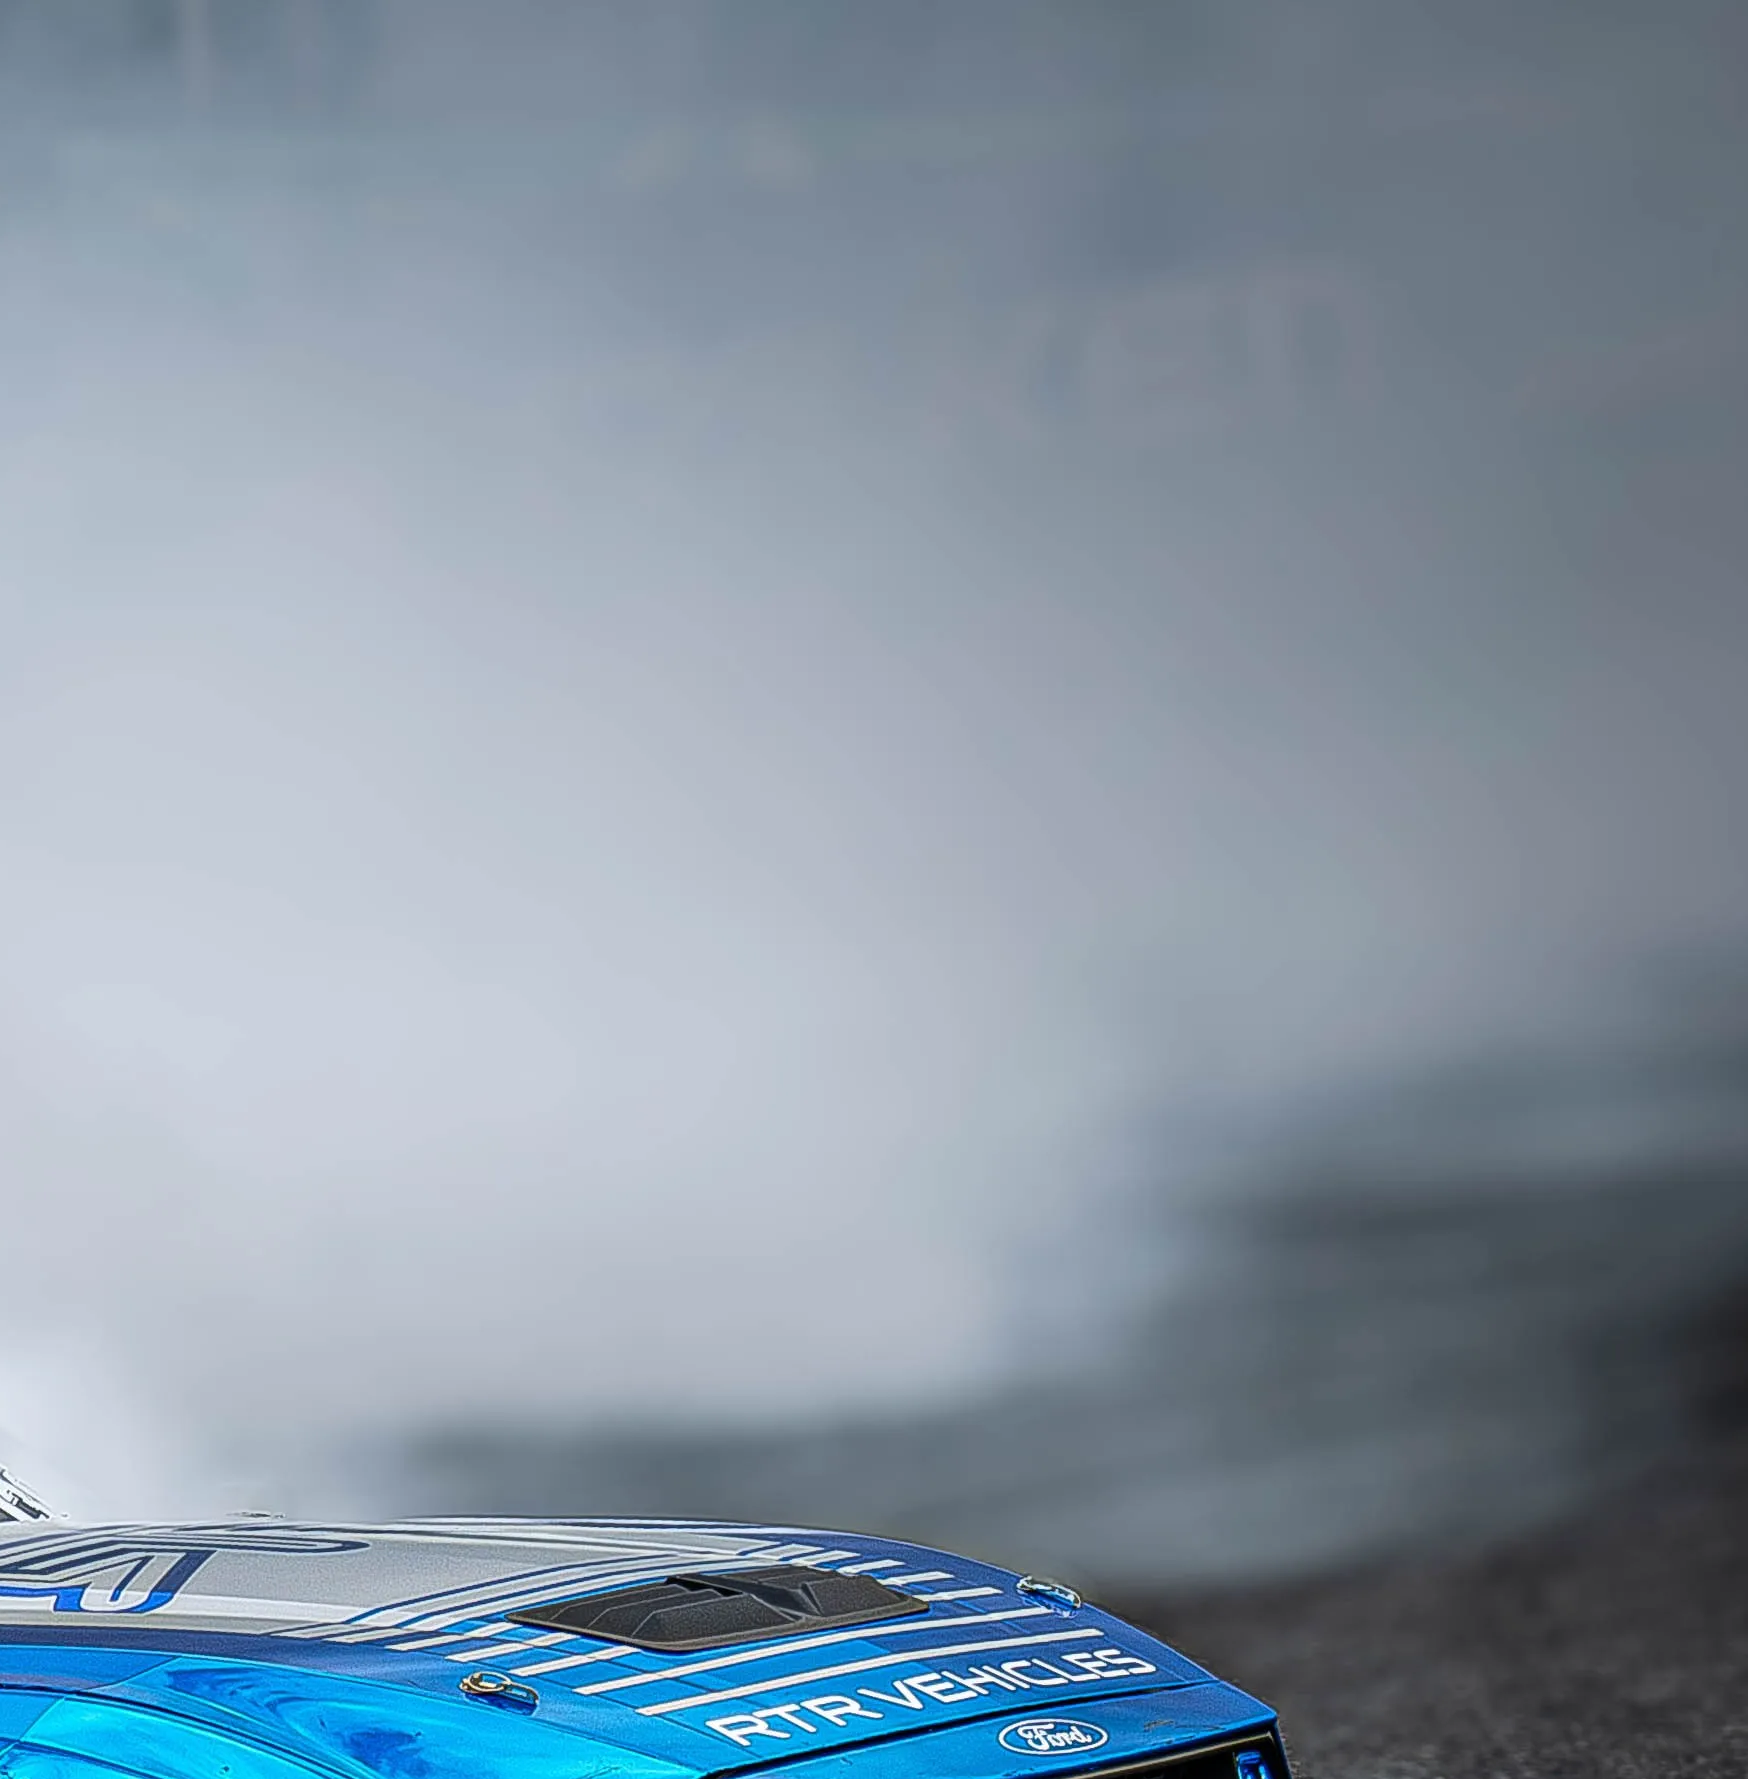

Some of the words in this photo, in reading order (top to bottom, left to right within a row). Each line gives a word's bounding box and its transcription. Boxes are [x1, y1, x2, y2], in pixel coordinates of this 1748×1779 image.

[704, 1694, 884, 1748] RTR
[856, 1649, 1159, 1711] VEHICLES
[1020, 1723, 1094, 1751] Ford
